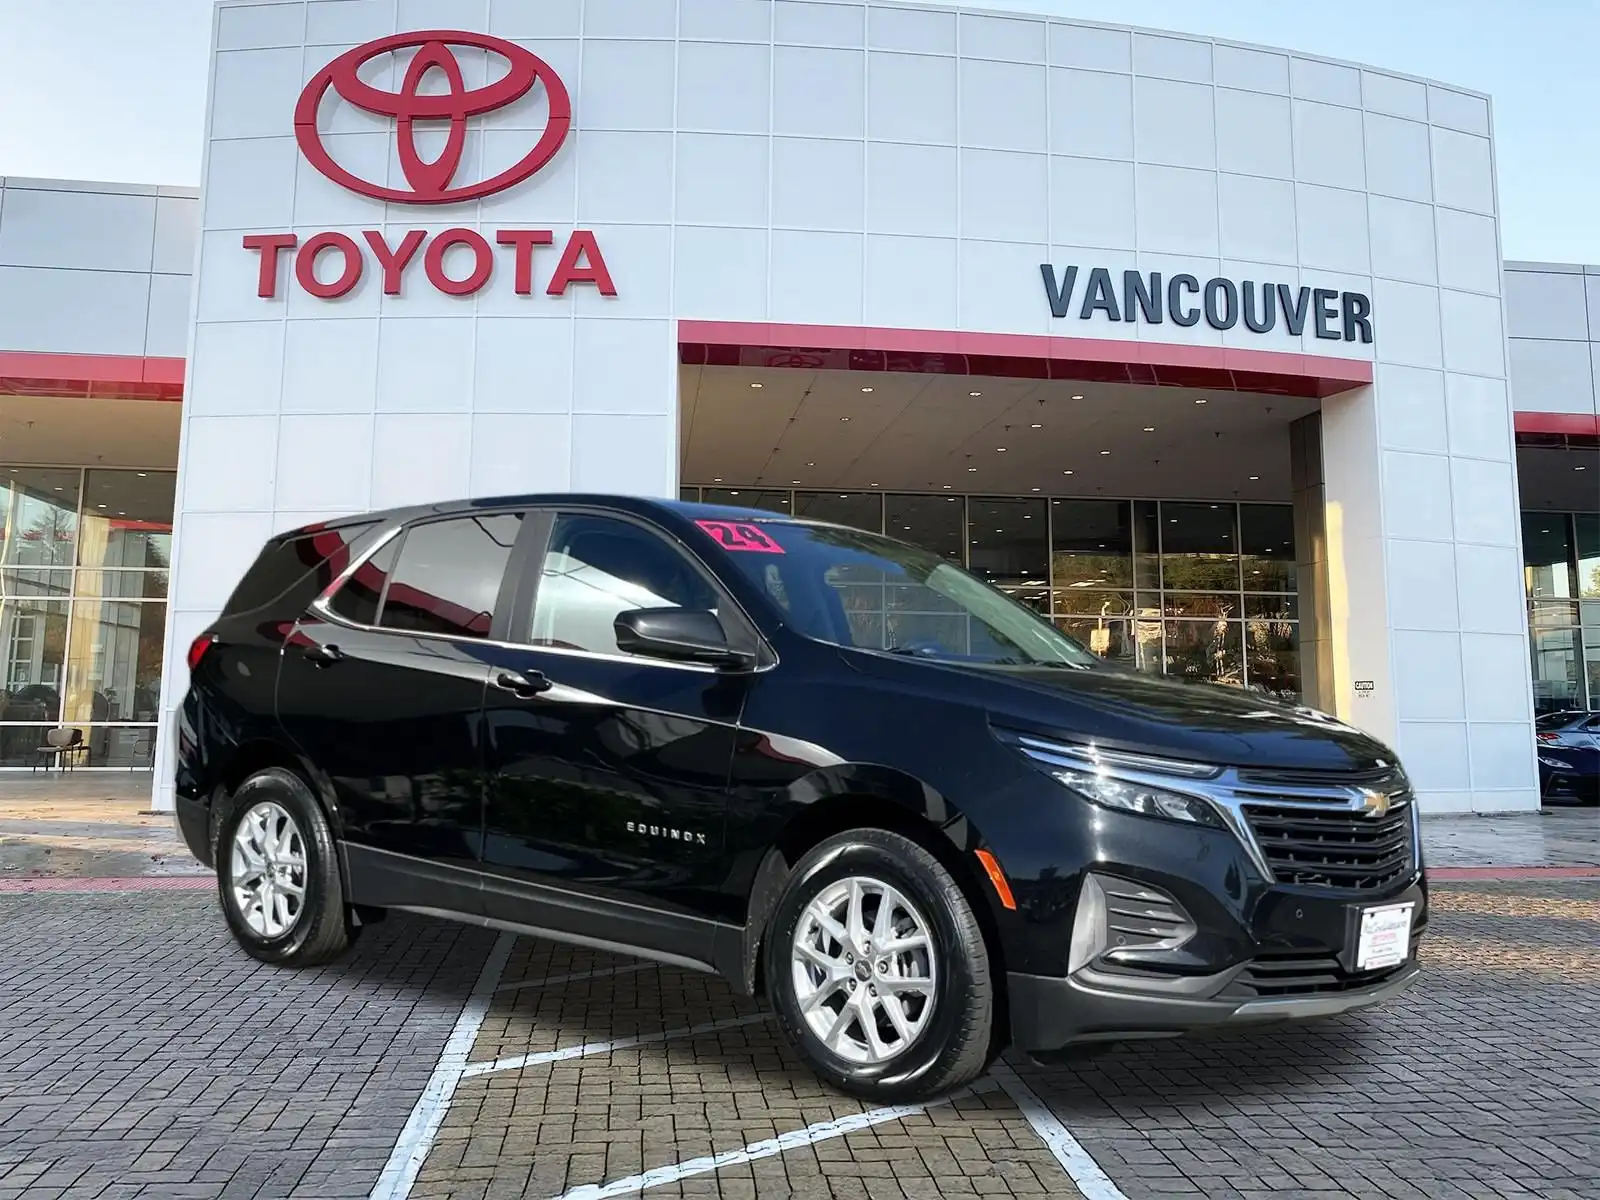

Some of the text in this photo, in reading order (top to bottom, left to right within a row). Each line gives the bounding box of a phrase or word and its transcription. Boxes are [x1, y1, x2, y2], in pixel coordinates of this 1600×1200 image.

[243, 227, 617, 299] TOYOTA
[1040, 263, 1373, 343] VANCOUVER
[703, 523, 772, 548] 24
[626, 821, 706, 845] EQUINOX
